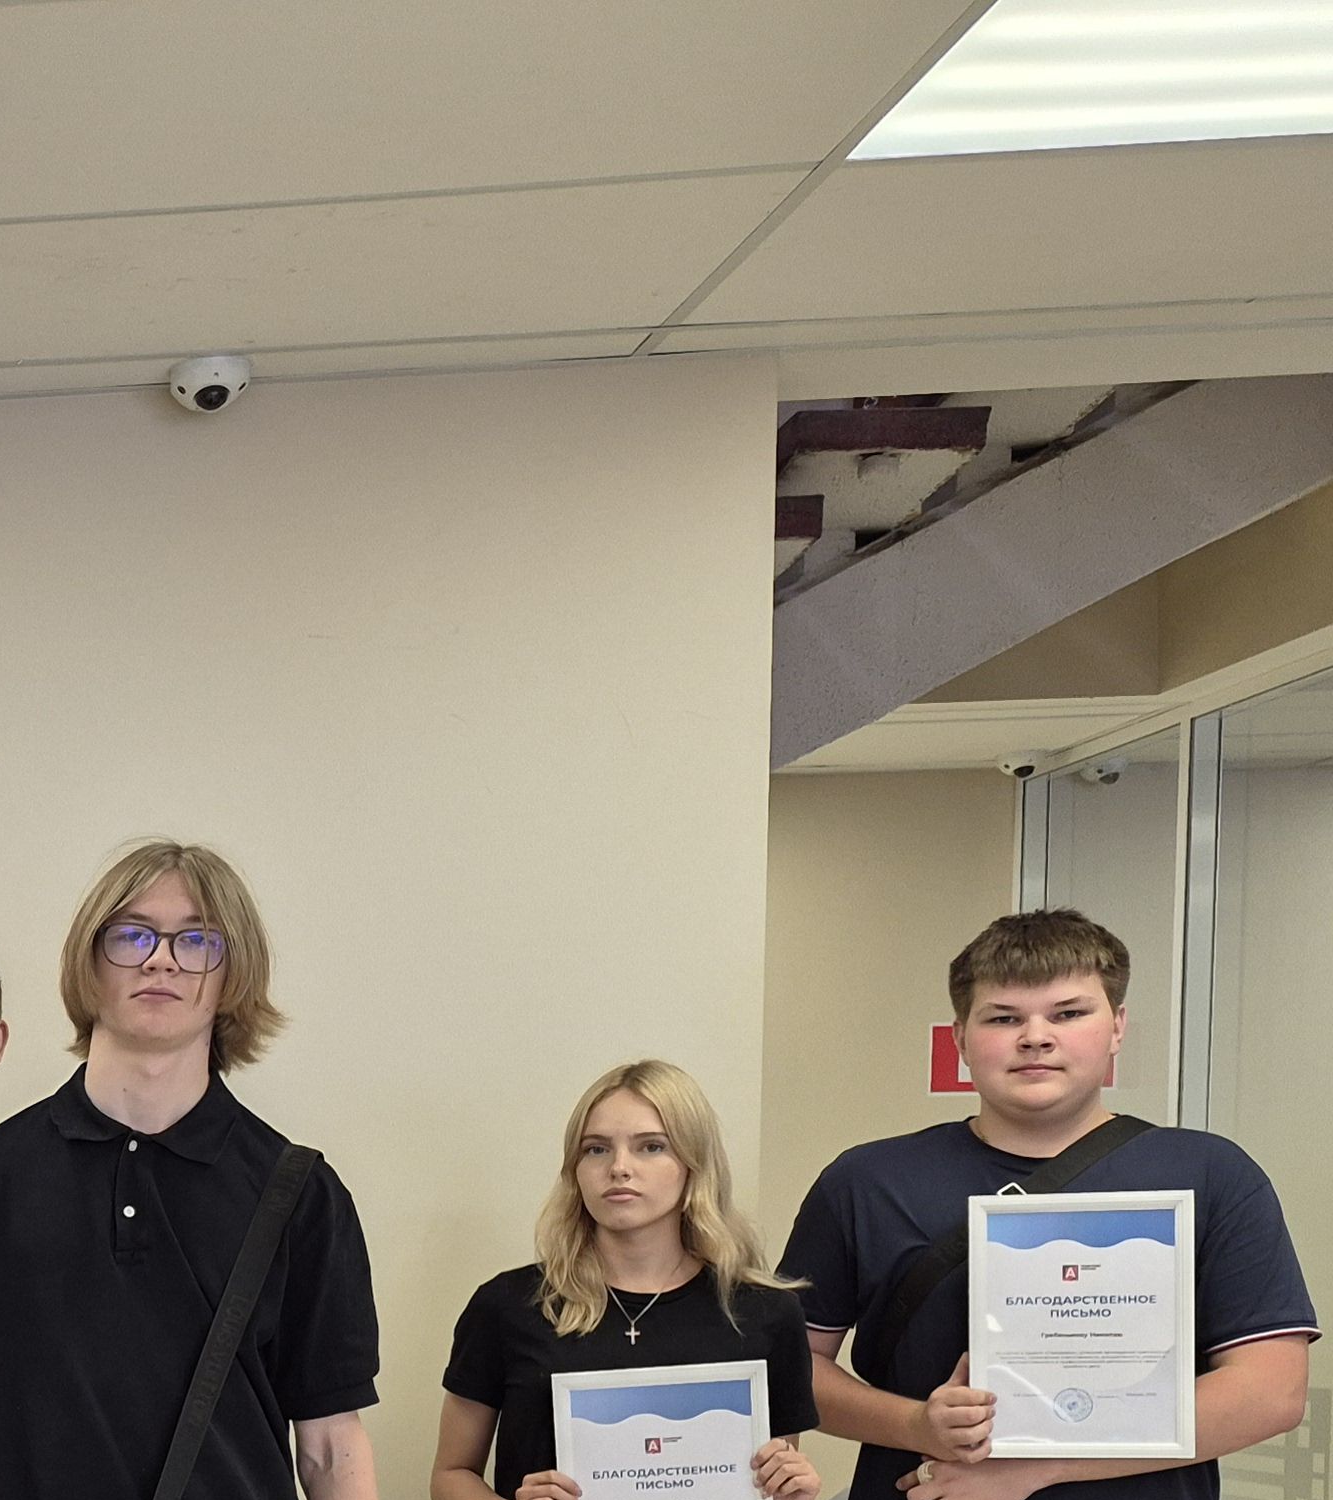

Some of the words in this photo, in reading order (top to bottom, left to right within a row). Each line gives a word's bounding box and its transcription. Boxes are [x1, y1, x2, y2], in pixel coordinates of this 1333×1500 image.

[1005, 1294, 1157, 1307] БЛАГОДАРСТВЕННОЕ
[1050, 1308, 1111, 1318] ПИСЬМО
[592, 1463, 737, 1481] БЛАГОДАРСТВЕННОЕ
[635, 1479, 694, 1491] ПИСЬМО
